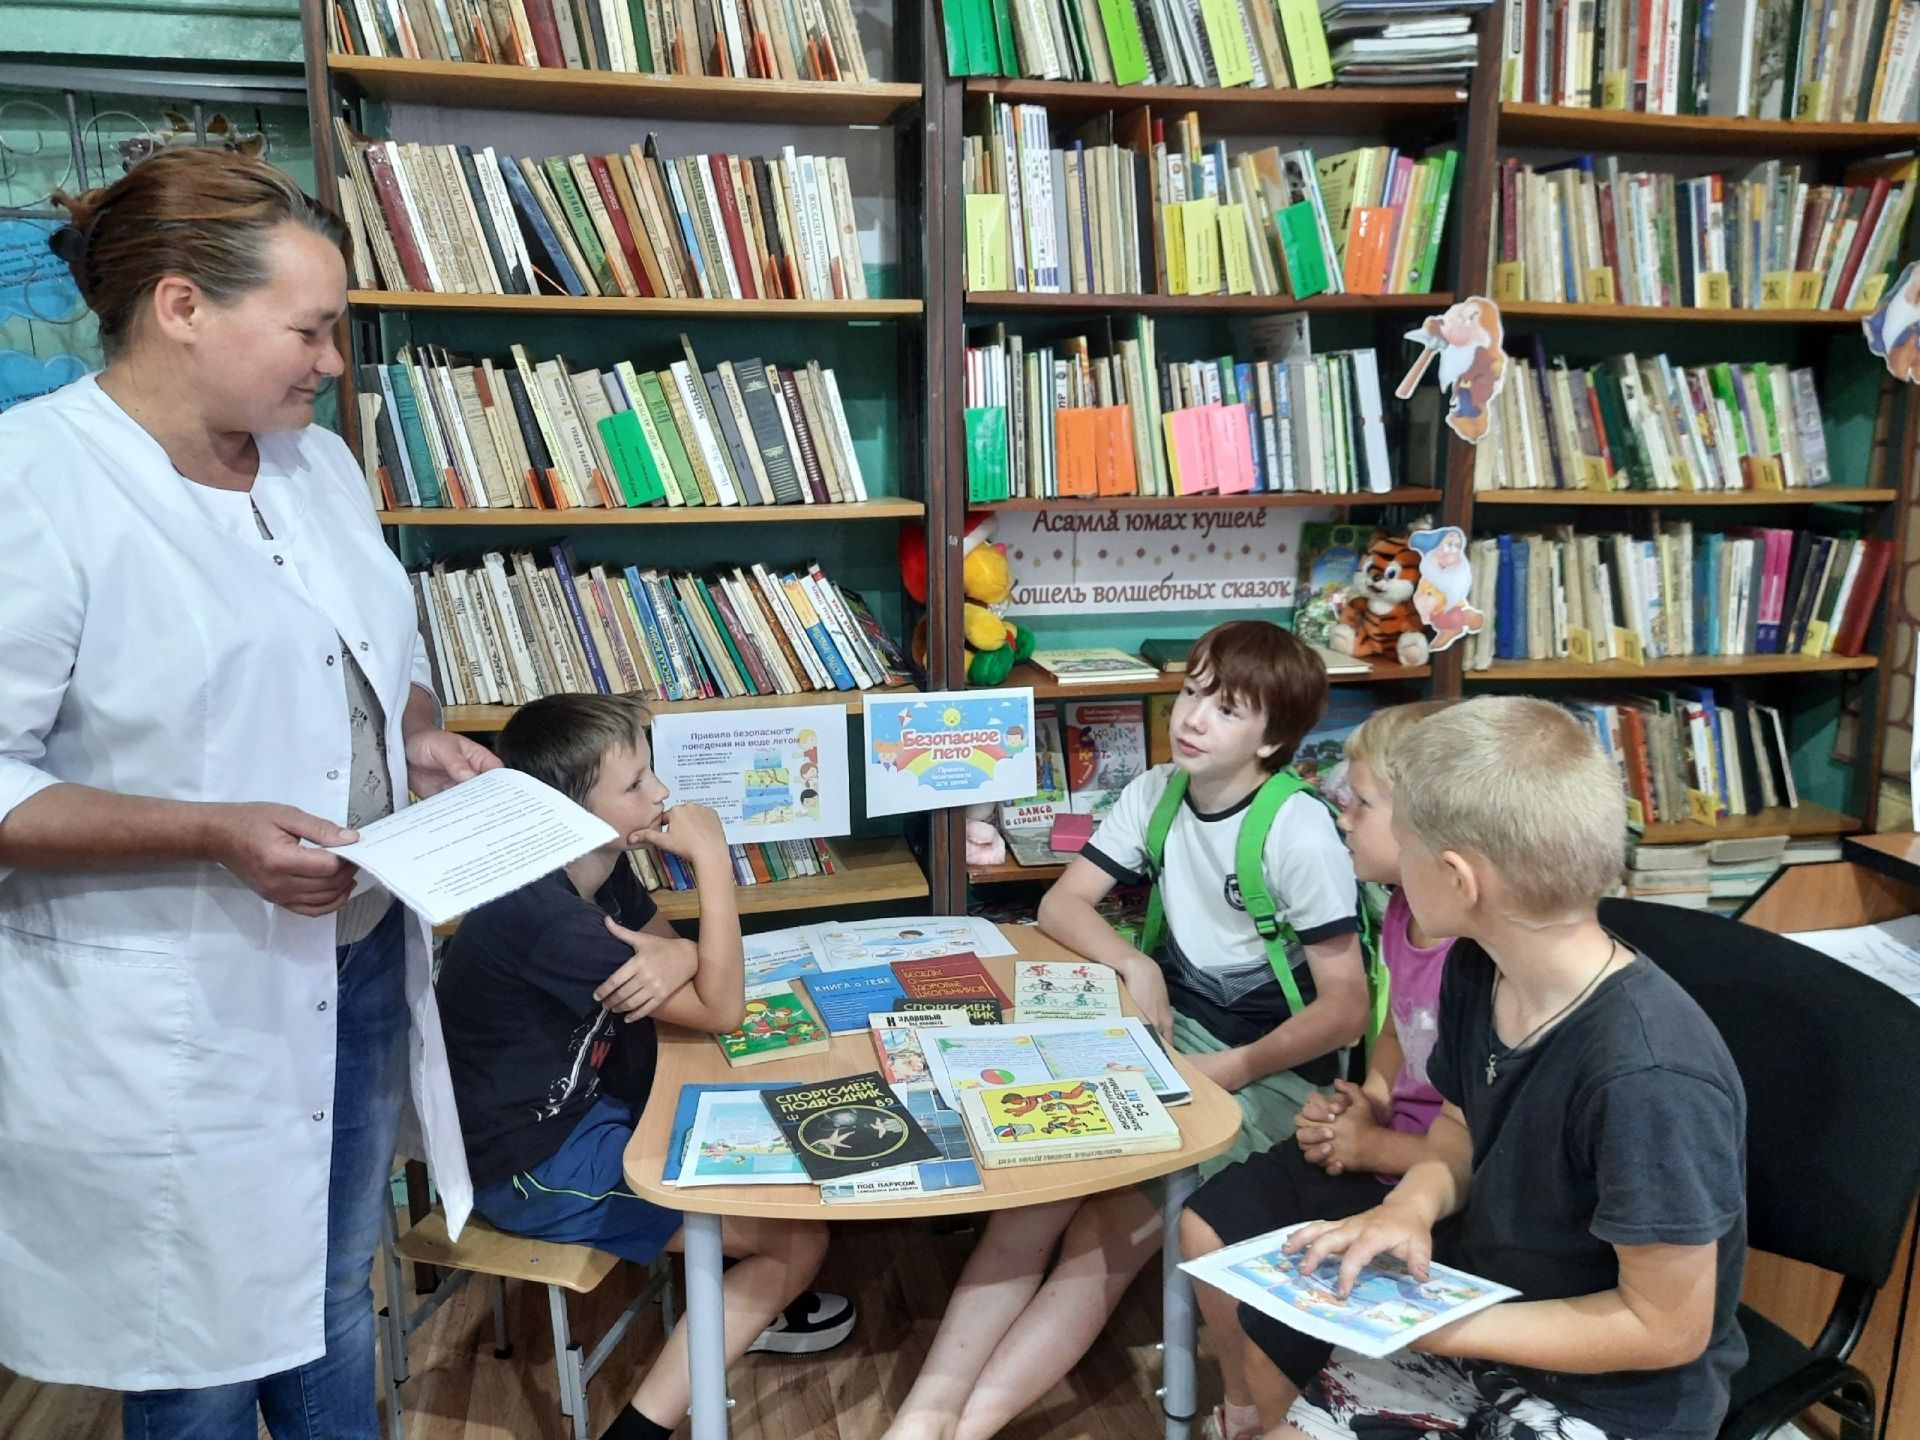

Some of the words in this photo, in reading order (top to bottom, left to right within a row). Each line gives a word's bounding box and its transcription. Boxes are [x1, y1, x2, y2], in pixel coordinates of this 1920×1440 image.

[559, 175, 584, 219] ПОВЕСТИ
[788, 169, 801, 213] Иваныча
[807, 191, 822, 236] ПЕТУХОВ
[796, 214, 810, 261] Позовите
[815, 239, 829, 281] Анатолий
[683, 373, 706, 420] МИКЕШ
[1126, 511, 1188, 531] юмах
[1093, 571, 1216, 602] волшебных
[1222, 578, 1292, 599] сказок
[647, 623, 662, 652] ВОЙНА
[656, 652, 676, 695] ТРОЯНСКАЯ
[682, 741, 732, 751] поведения
[748, 740, 771, 748] воде
[773, 737, 800, 745] летом
[690, 731, 731, 741] Правила
[733, 728, 792, 738] безопасного
[902, 730, 999, 747] Безопасное
[932, 747, 972, 760] лето
[1013, 815, 1042, 825] СТРАНЕ
[1018, 804, 1053, 816] АЛИСА
[904, 969, 942, 978] БЕСЕДЫ
[814, 983, 851, 993] КНИГА
[865, 977, 892, 986] ТЕБЕ
[912, 980, 962, 991] ЗДОРОВЬЕ
[914, 985, 987, 999] ШКОЛЬНИКОВ
[886, 1016, 897, 1027] К
[898, 1014, 942, 1022] ЗДОРОВЬЮ
[776, 1081, 876, 1104] СПОРТСМЕН-
[1106, 1078, 1126, 1100] ДЕТЬМИ
[1124, 1089, 1141, 1101] ЛЕТ
[780, 1088, 885, 1113] ПОДВОДНИК
[1098, 1081, 1131, 1130] ФИЗКУЛЬТУРНЫЕ
[1132, 1103, 1149, 1116] 5-6
[1122, 1105, 1143, 1131] ЗАНЯТИЯ
[877, 1180, 916, 1188] ПАРУСОМ
